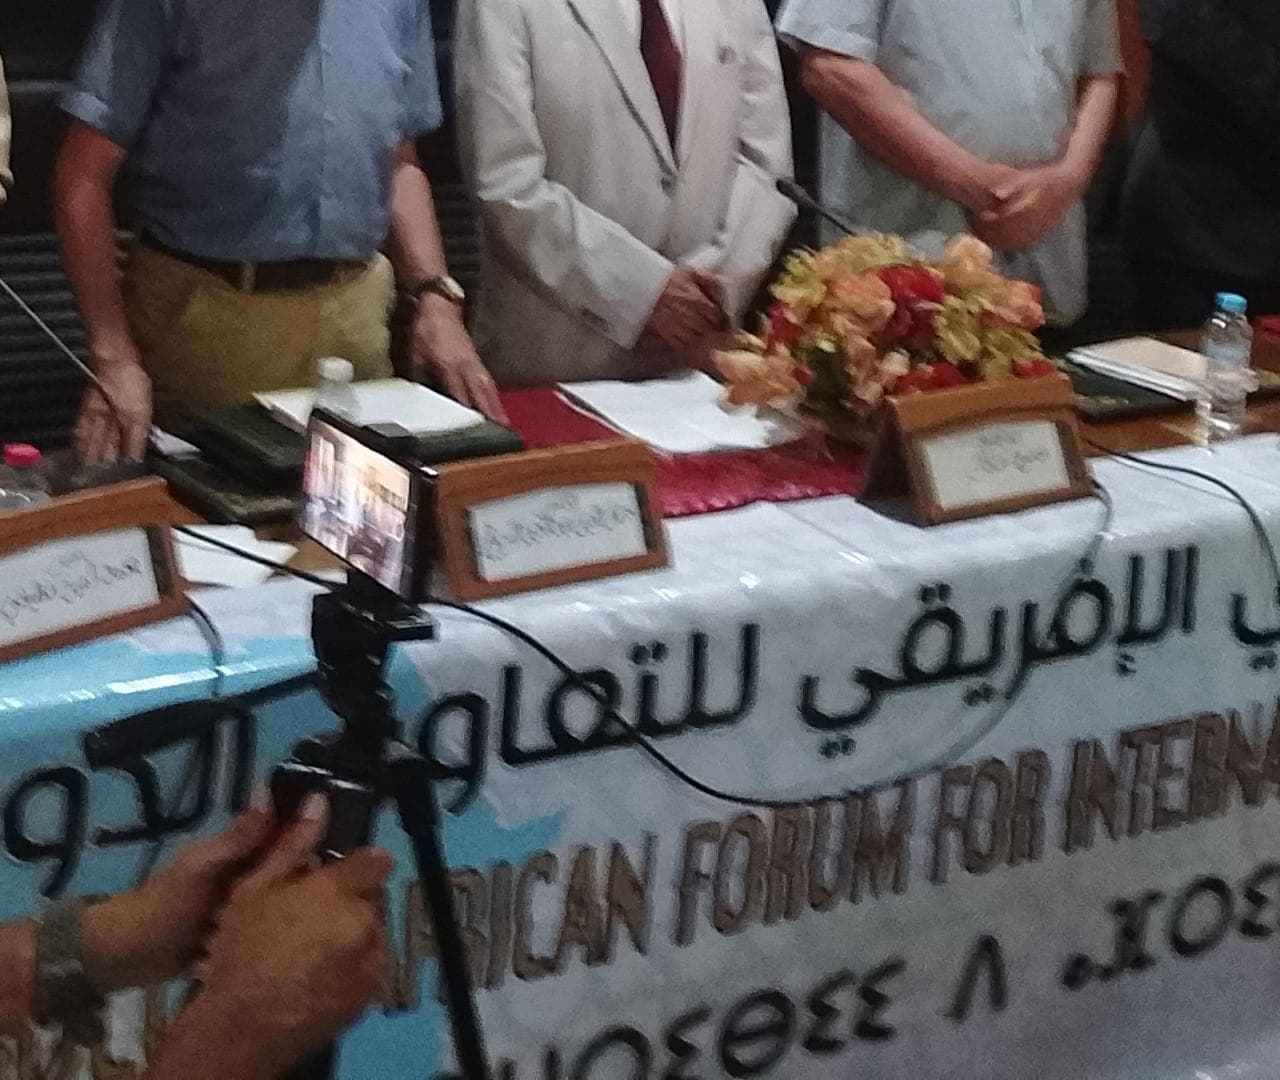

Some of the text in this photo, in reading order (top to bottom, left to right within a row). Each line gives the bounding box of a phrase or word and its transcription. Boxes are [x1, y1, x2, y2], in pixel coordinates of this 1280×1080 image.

[417, 618, 762, 818] للتعاو
[794, 542, 1202, 760] الإفريقي
[380, 828, 660, 1014] FRICAN
[665, 780, 920, 950] FORUM
[923, 746, 1053, 888] FOR
